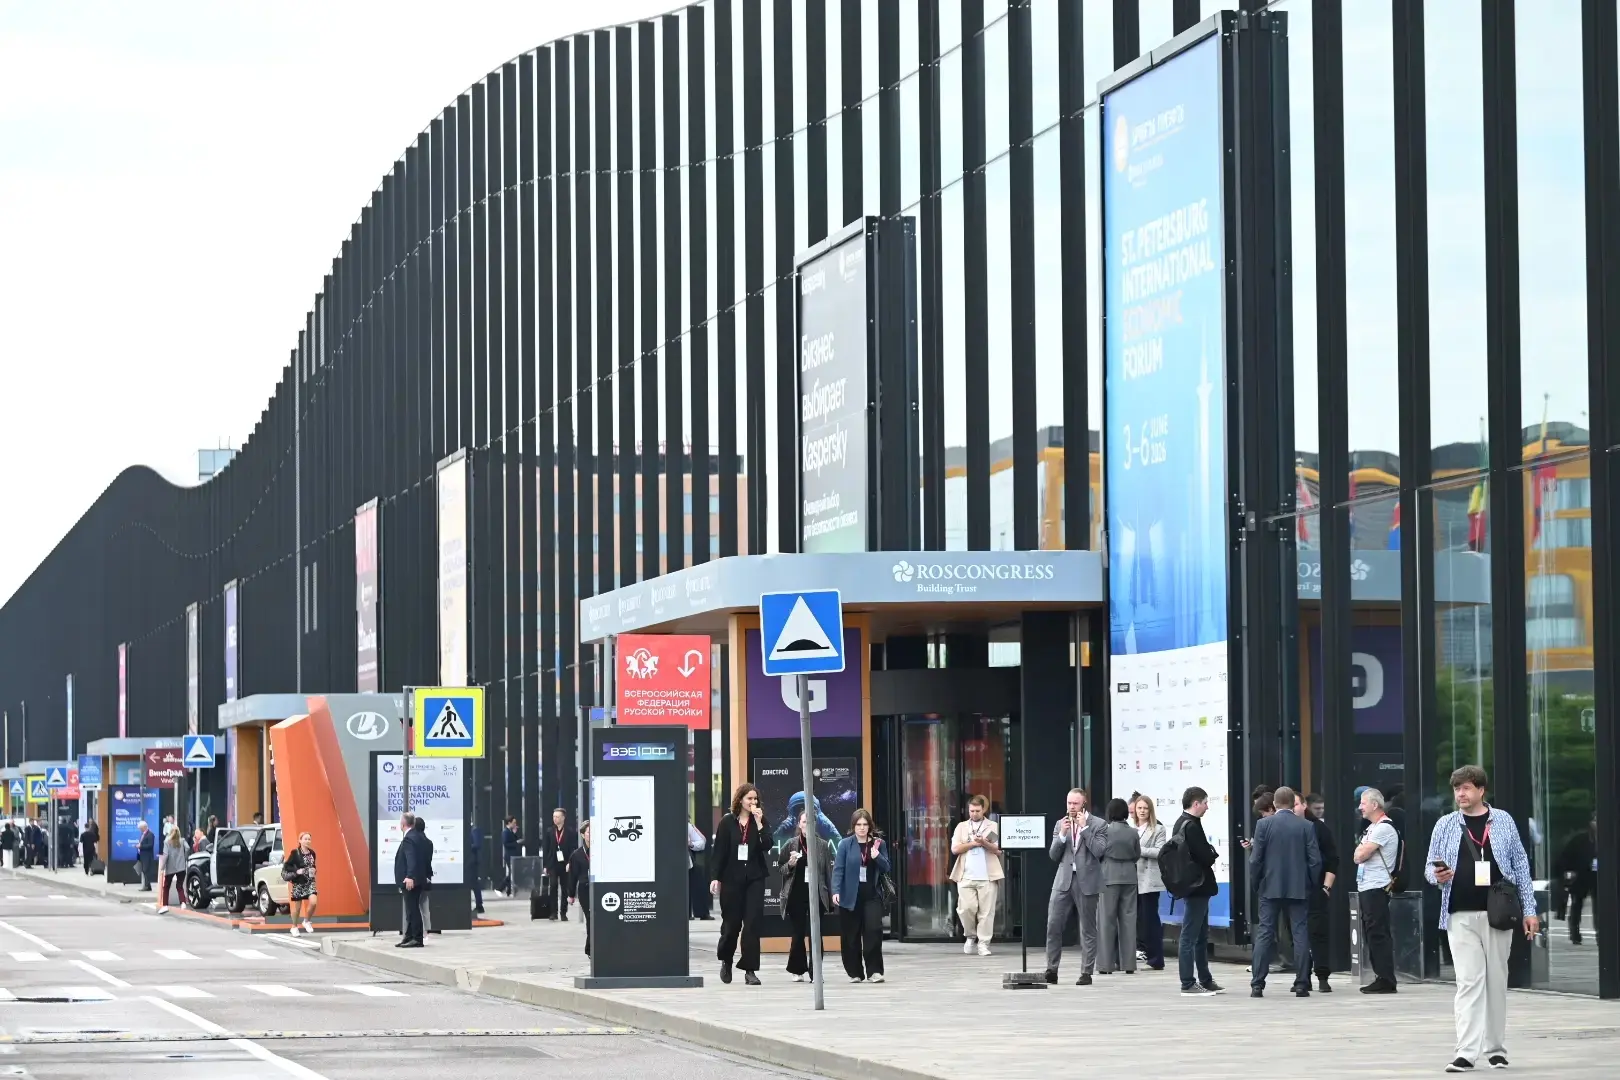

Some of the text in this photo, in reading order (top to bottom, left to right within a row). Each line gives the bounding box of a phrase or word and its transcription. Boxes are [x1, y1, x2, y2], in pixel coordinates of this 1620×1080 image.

[1121, 197, 1208, 268] ST. PETERSBURG
[1121, 235, 1215, 305] INTERNATIONAL
[801, 331, 835, 373] Бизнес
[1122, 336, 1163, 381] FORUM
[802, 377, 847, 423] выбирает
[1150, 413, 1169, 439] JUNE
[802, 422, 848, 478] Kaspersky
[916, 564, 1054, 580] ROSCONGRESS
[917, 583, 977, 595] Building Trust
[624, 688, 703, 698] ВСЕРОССИЙСКАЯ
[637, 699, 690, 709] ФЕДЕРАЦИЯ
[624, 706, 703, 717] РУССКОЙ ТРОЙКИ
[762, 768, 789, 776] ДОНСТРОЙ
